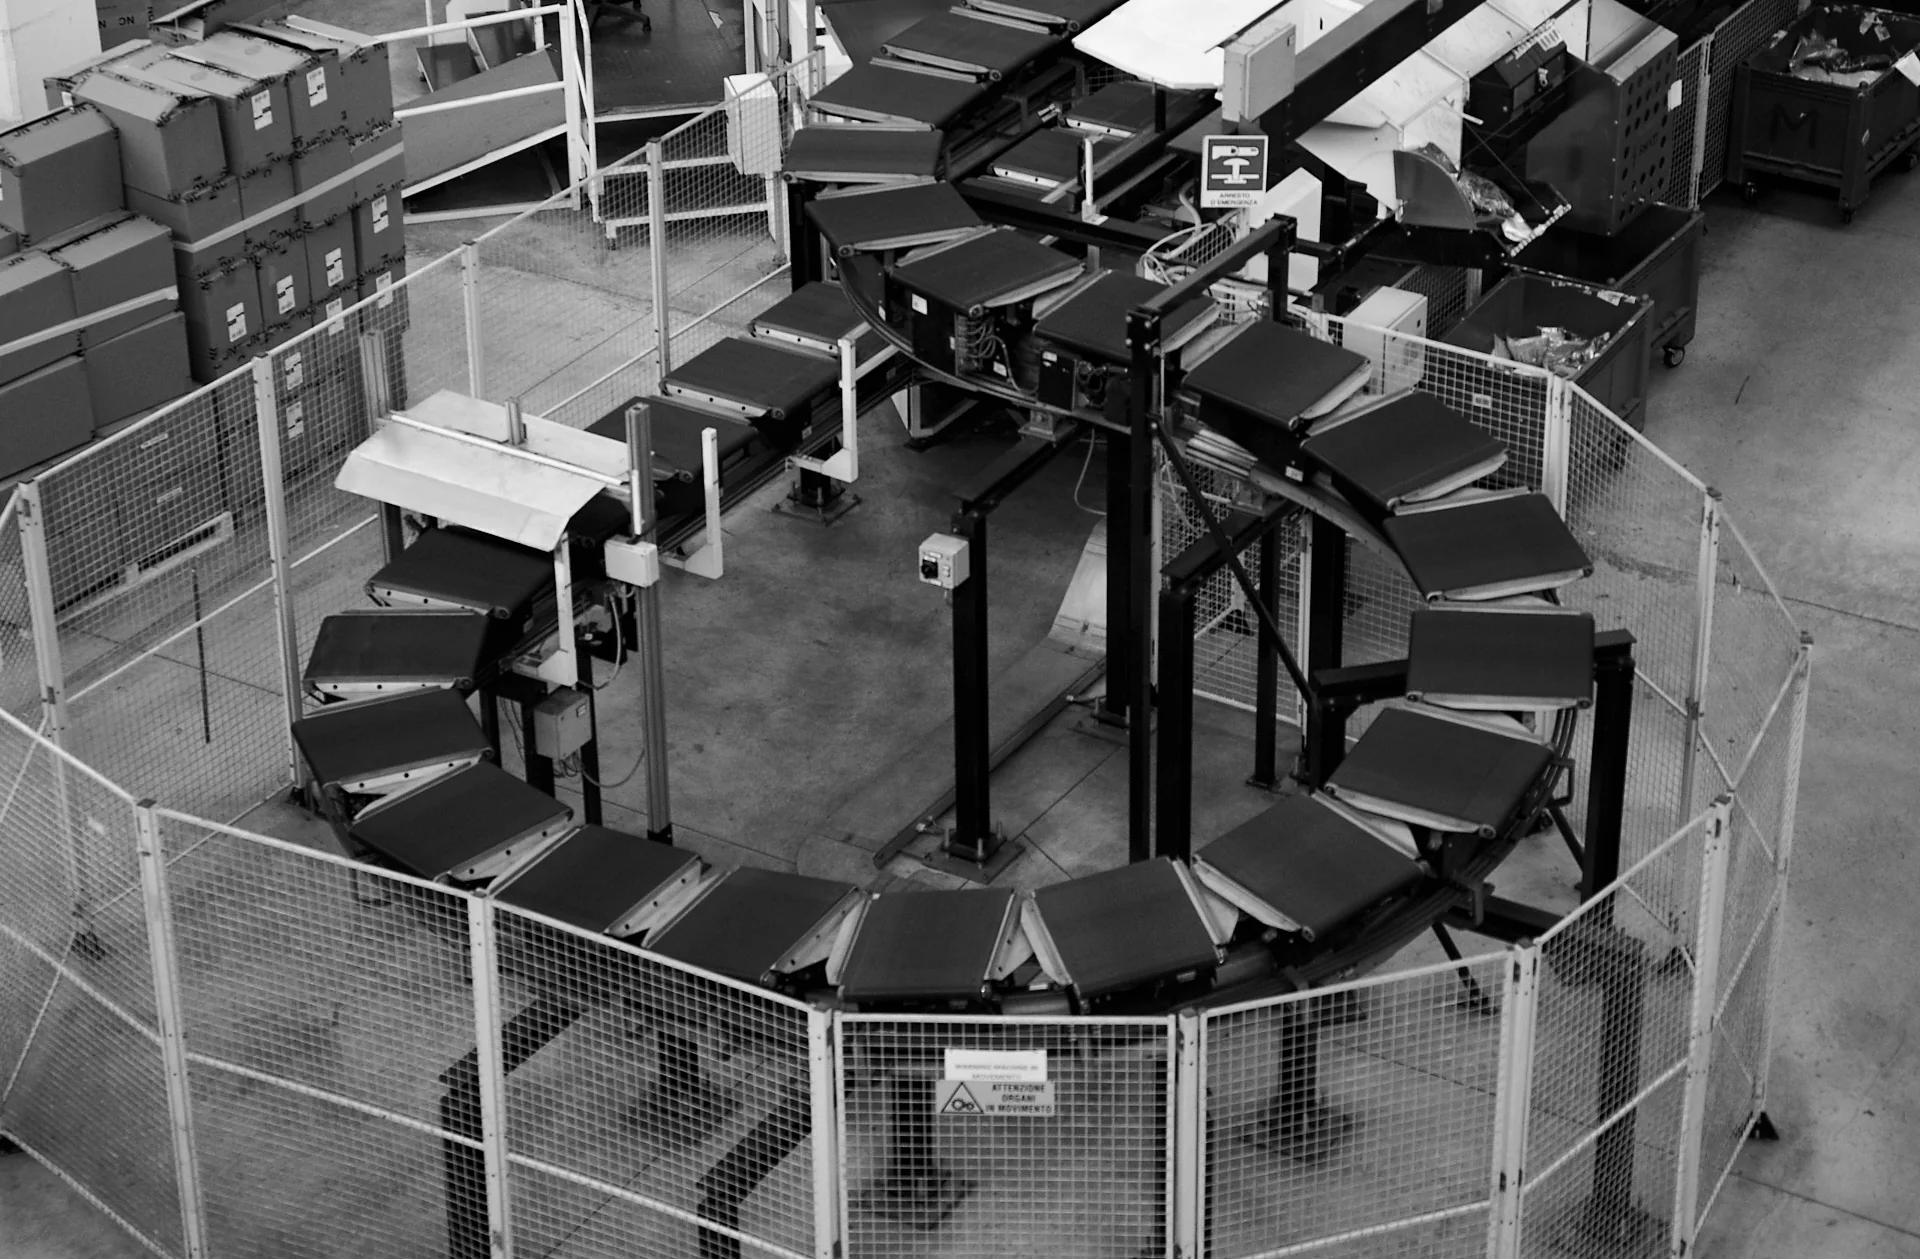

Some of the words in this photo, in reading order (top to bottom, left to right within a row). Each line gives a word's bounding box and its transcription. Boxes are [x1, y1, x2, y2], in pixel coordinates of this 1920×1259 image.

[1769, 103, 1820, 150] M
[992, 1084, 1045, 1093] ATTENZIONE
[985, 1105, 995, 1113] IN
[998, 1105, 1052, 1114] MOVIMENTO
